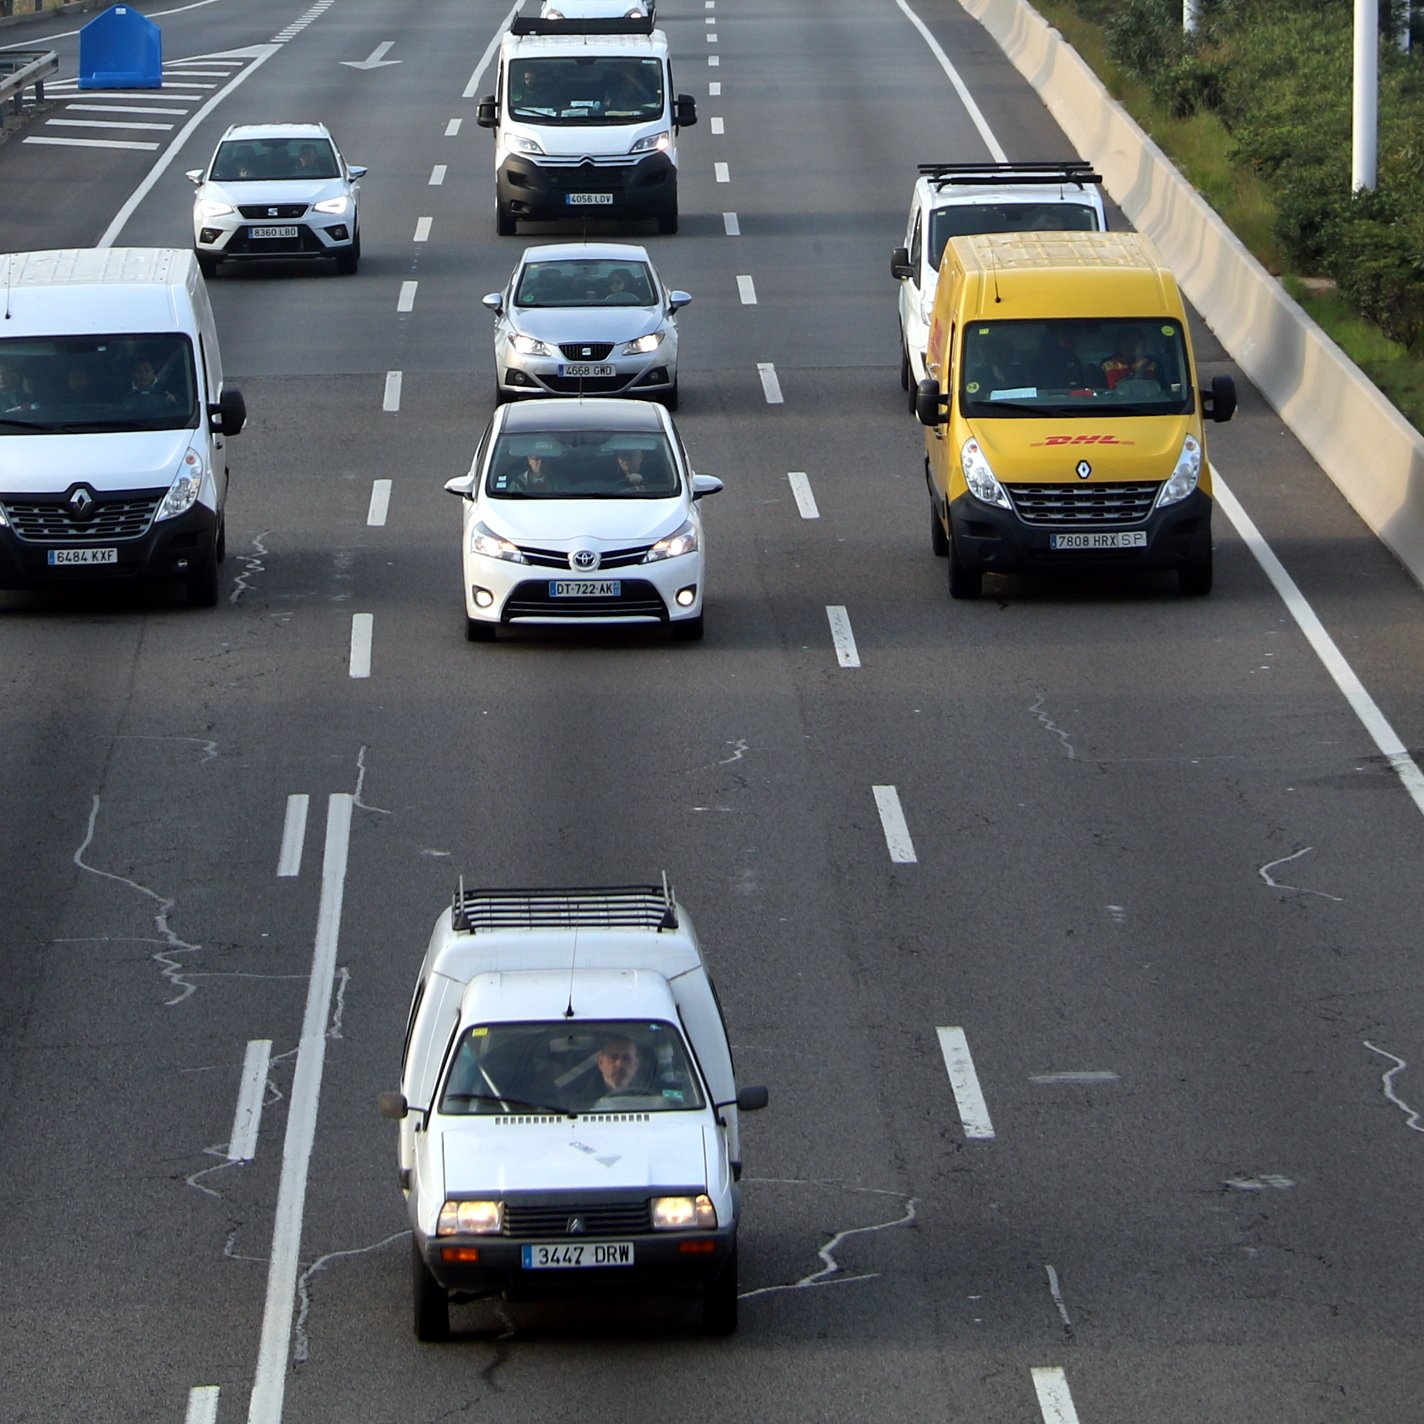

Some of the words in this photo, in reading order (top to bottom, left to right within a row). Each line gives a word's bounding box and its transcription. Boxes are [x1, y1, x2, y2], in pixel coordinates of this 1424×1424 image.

[566, 366, 590, 376] 4668
[593, 366, 612, 375] GWD
[1044, 435, 1120, 446] DHL
[1058, 536, 1090, 547] 7808
[1093, 535, 1117, 547] HRX
[57, 551, 88, 563] 6484
[91, 549, 115, 562] KXF
[594, 1244, 629, 1263] DRW
